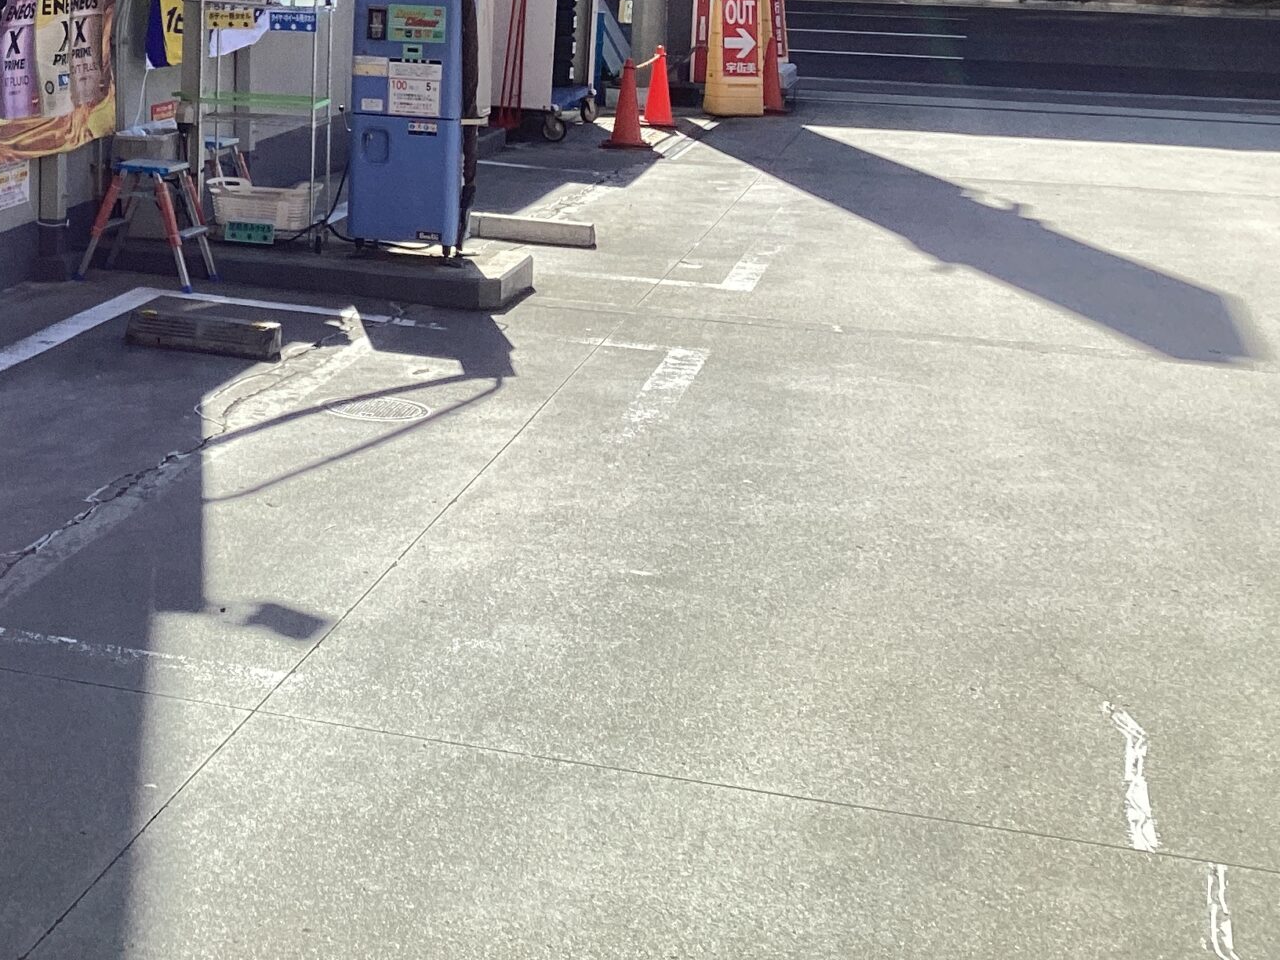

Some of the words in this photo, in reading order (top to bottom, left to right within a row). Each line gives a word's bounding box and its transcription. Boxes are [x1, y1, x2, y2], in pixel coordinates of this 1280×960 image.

[6, 1, 37, 22] ENEOS
[724, 0, 756, 25] OUT
[6, 26, 24, 59] X
[73, 17, 88, 48] X
[3, 58, 26, 72] PRIME
[725, 61, 757, 74] 宇佐美
